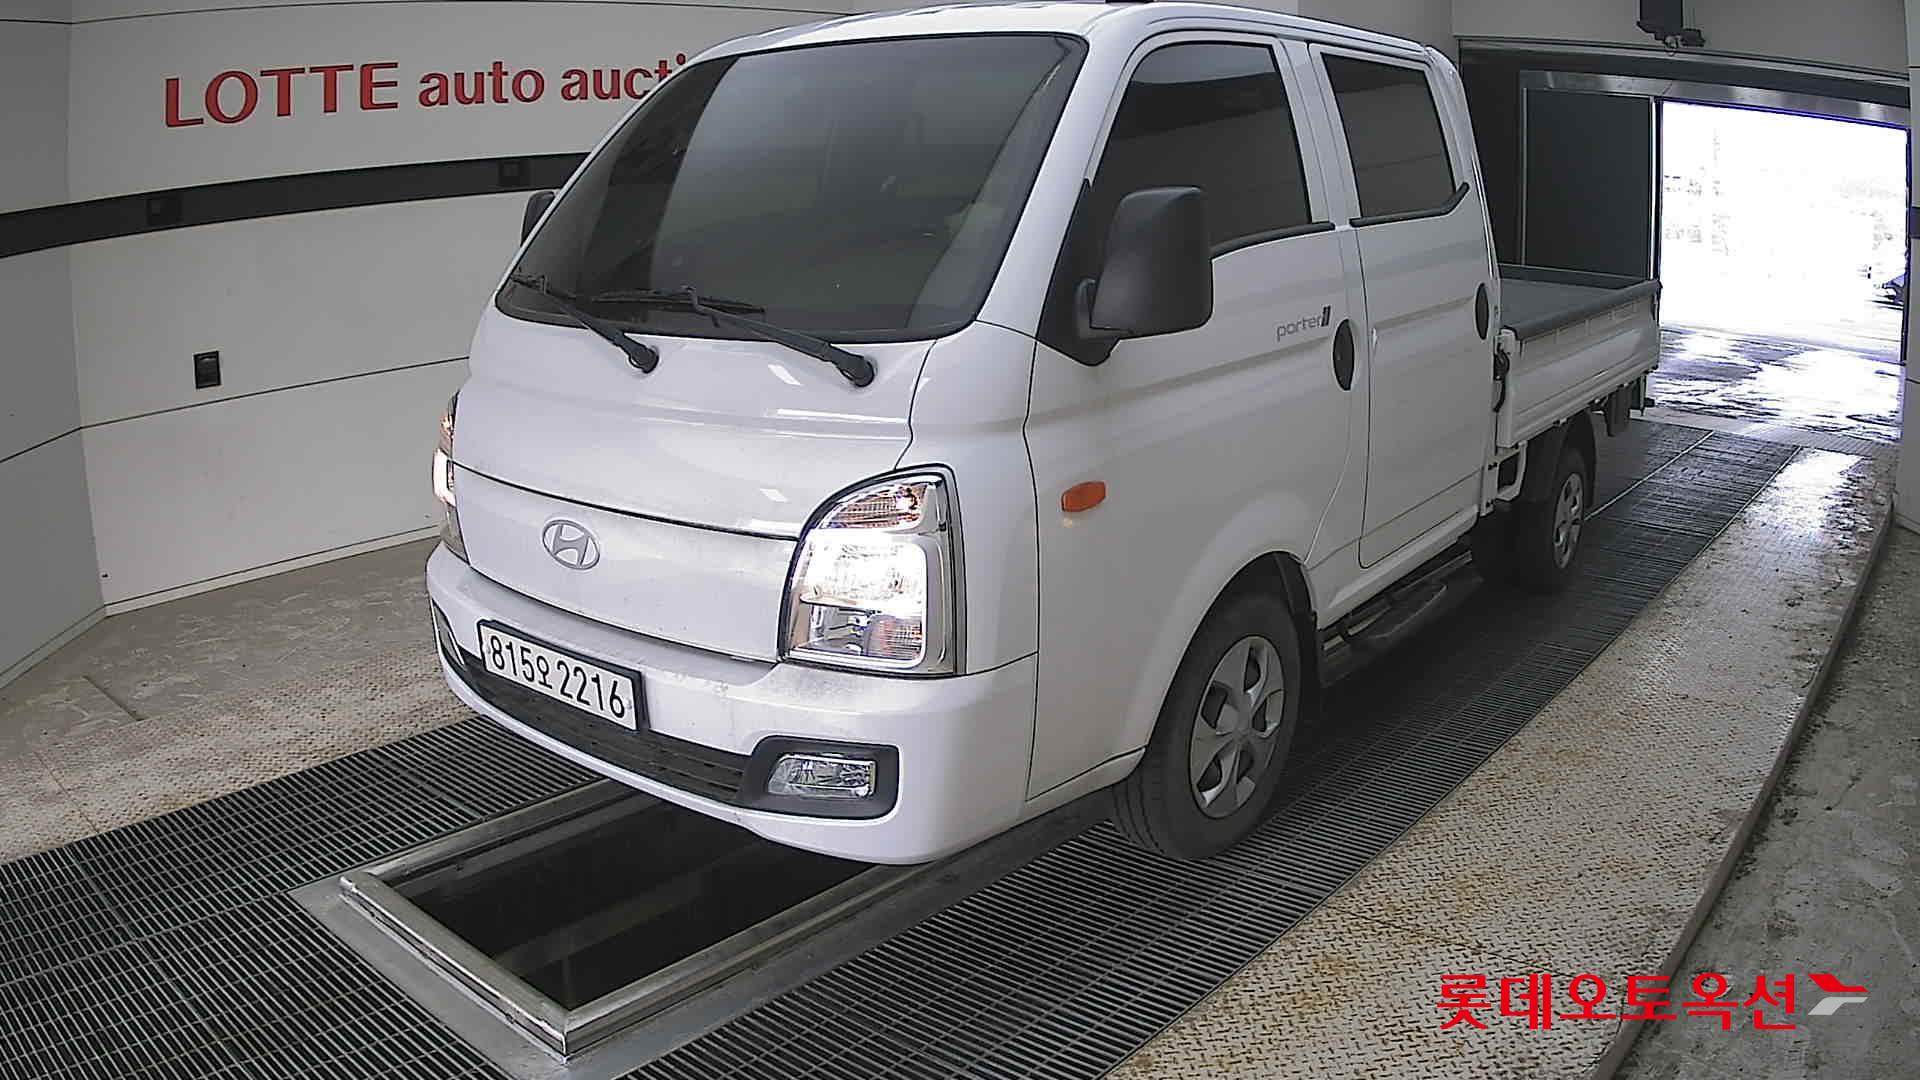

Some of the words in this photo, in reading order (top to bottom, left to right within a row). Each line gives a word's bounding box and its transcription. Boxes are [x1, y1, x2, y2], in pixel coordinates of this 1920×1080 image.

[165, 61, 399, 127] LOTTE
[418, 61, 546, 107] auto
[1276, 316, 1322, 343] porter
